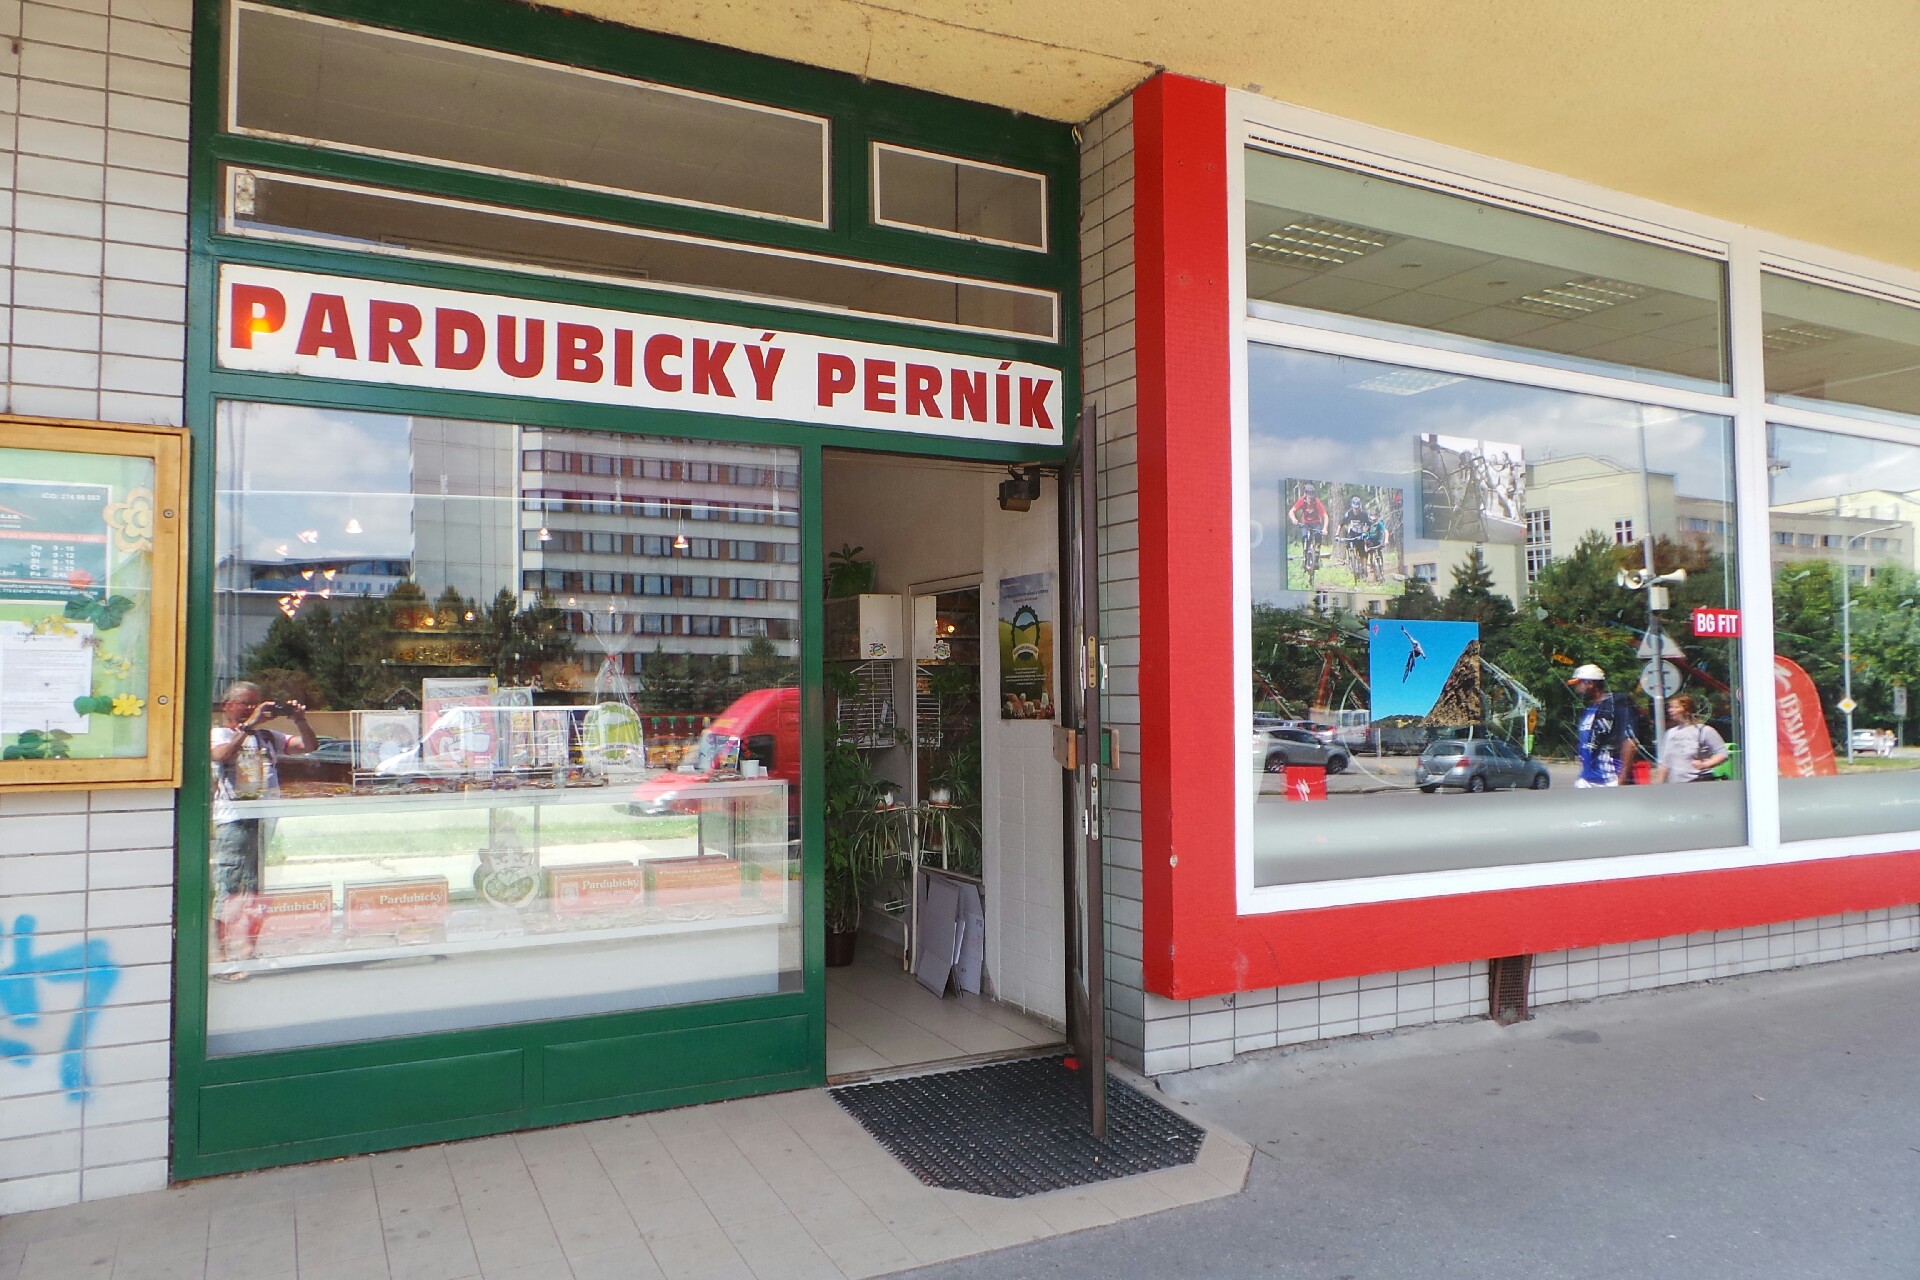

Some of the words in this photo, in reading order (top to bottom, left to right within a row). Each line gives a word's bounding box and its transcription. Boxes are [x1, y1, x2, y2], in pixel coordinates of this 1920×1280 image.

[231, 282, 786, 402] PARDUBICKÝ
[817, 353, 1055, 430] PERNÍK
[1697, 613, 1715, 632] BG
[1718, 614, 1738, 633] FIT
[582, 878, 640, 889] Pardubický
[379, 891, 444, 905] Pardubický
[257, 900, 327, 914] Pardubický
